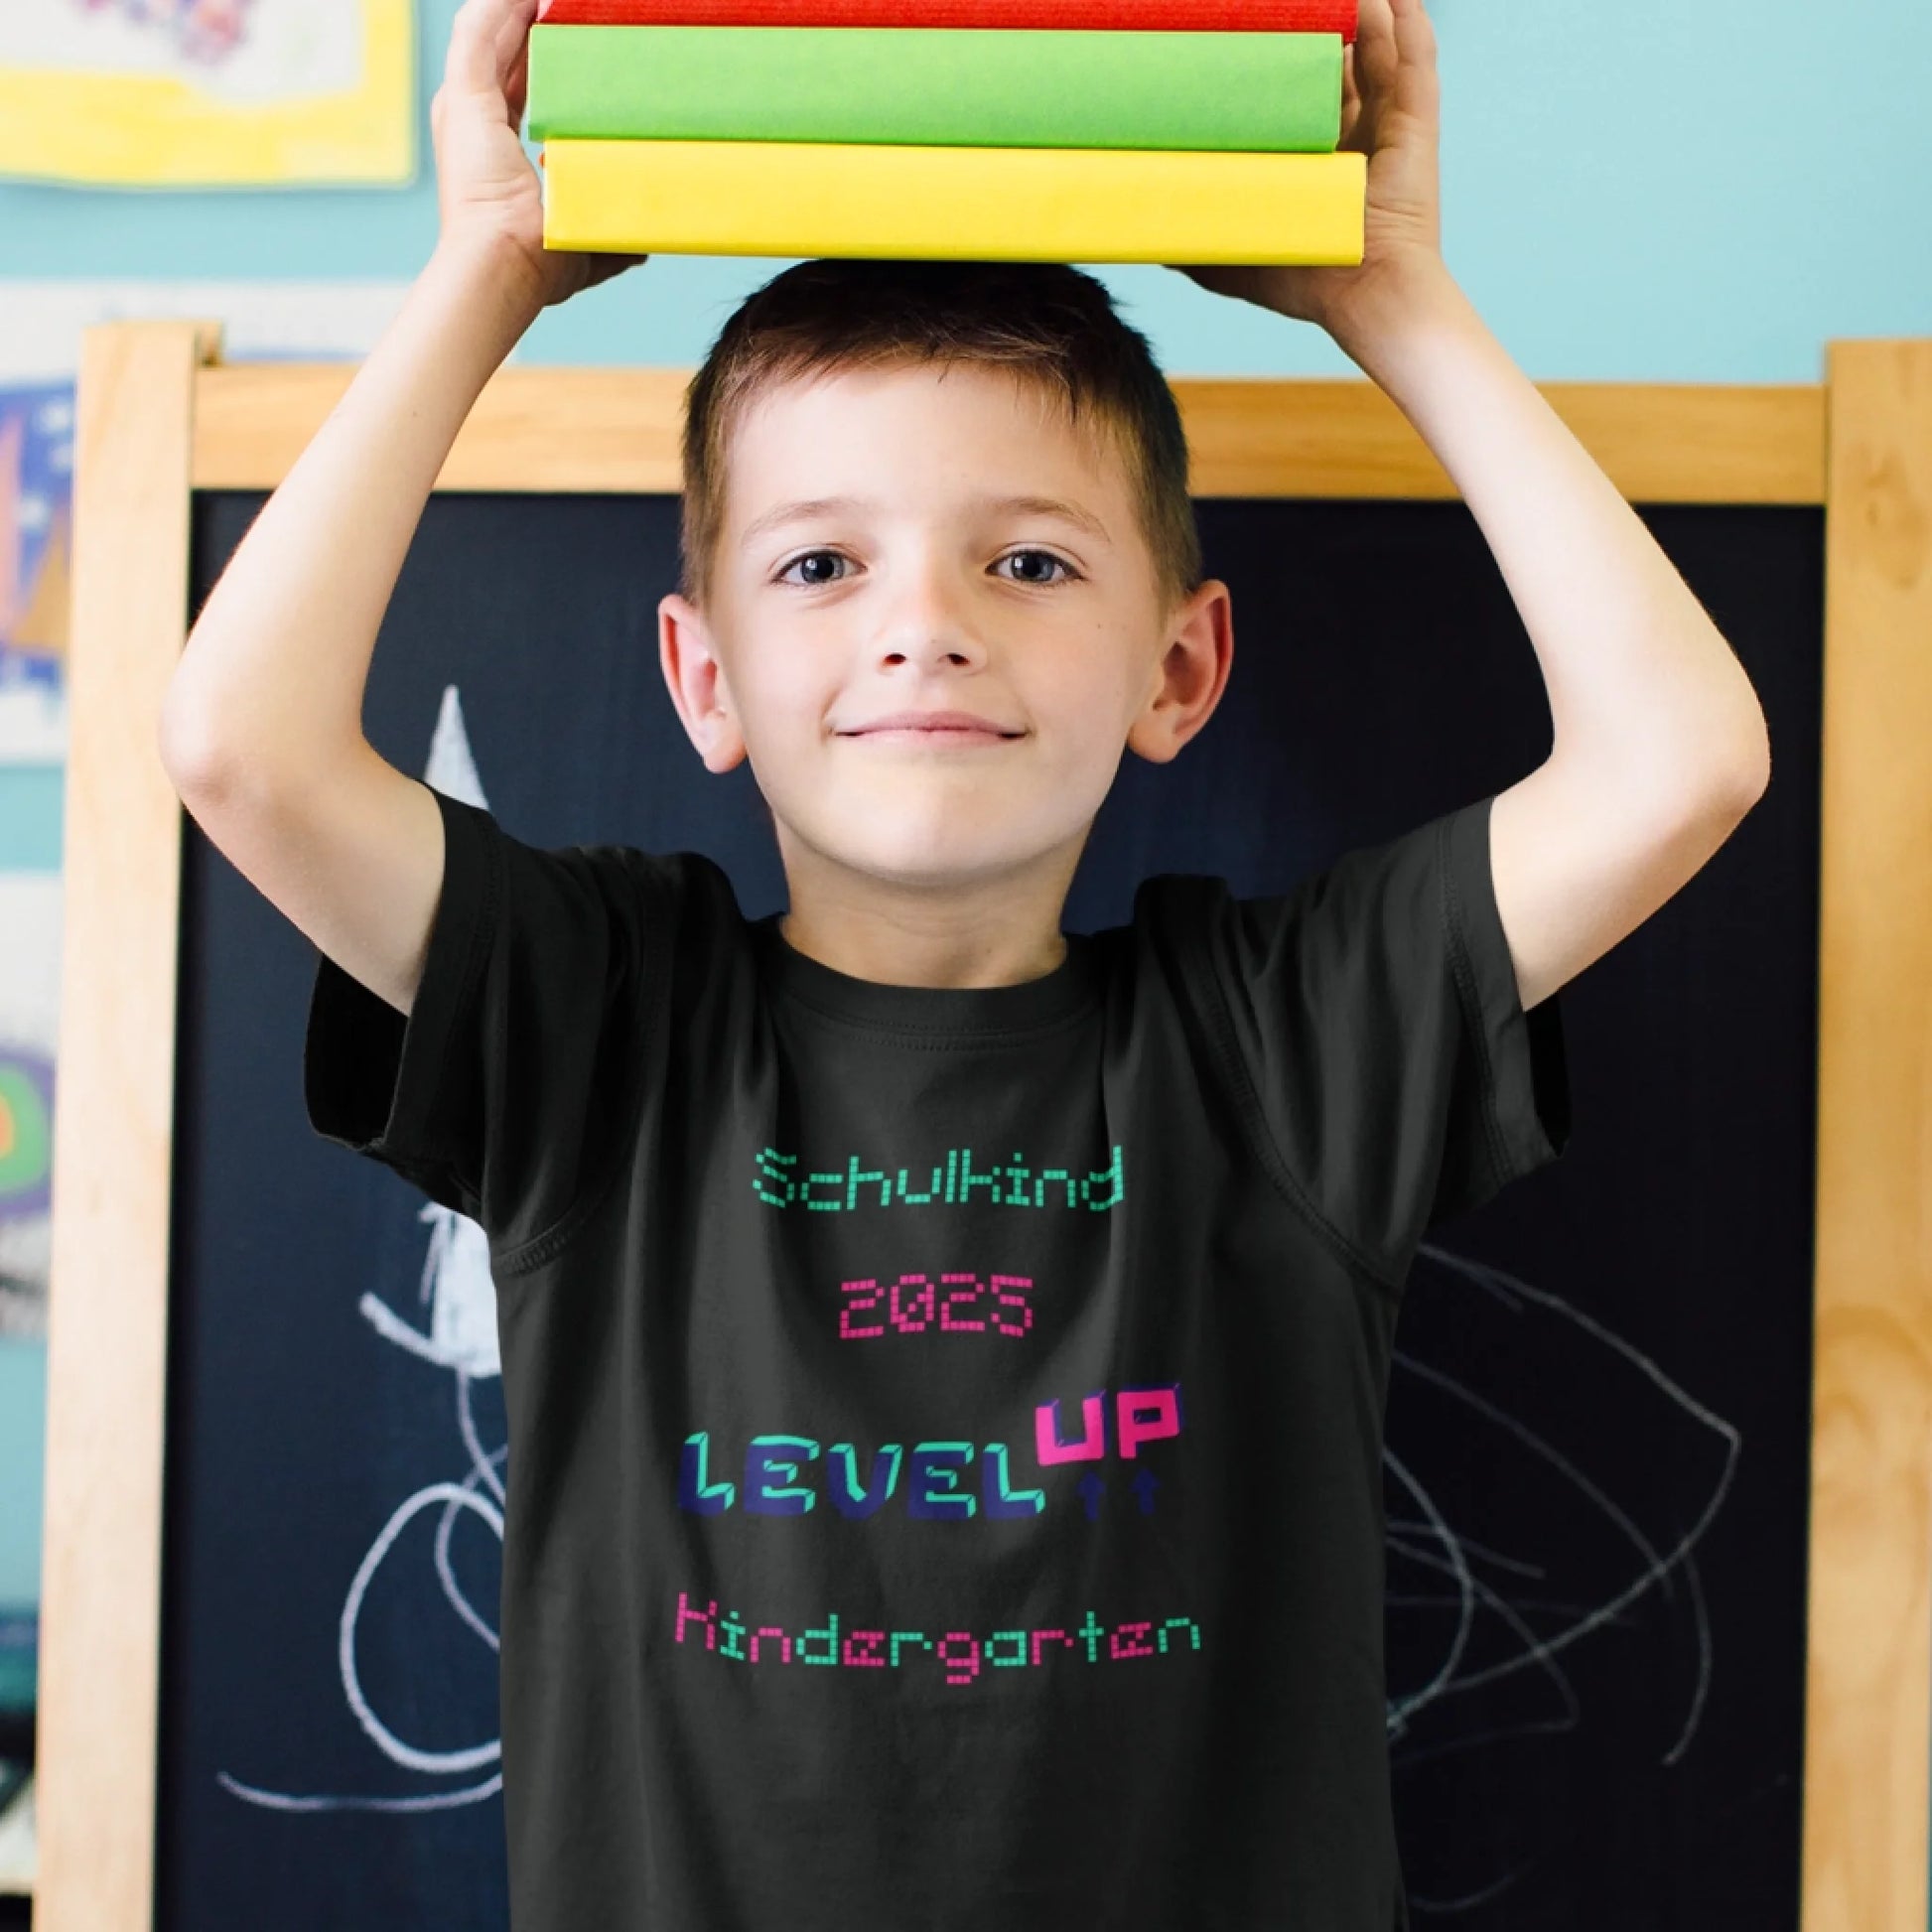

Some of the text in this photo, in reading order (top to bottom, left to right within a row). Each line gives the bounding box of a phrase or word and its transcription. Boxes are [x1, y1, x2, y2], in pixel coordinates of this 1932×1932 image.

[753, 1145, 1125, 1211] Schulkind
[839, 1272, 1034, 1339] 2025
[678, 1384, 1180, 1520] LEVEL UP
[674, 1591, 1200, 1685] Kindergarten
